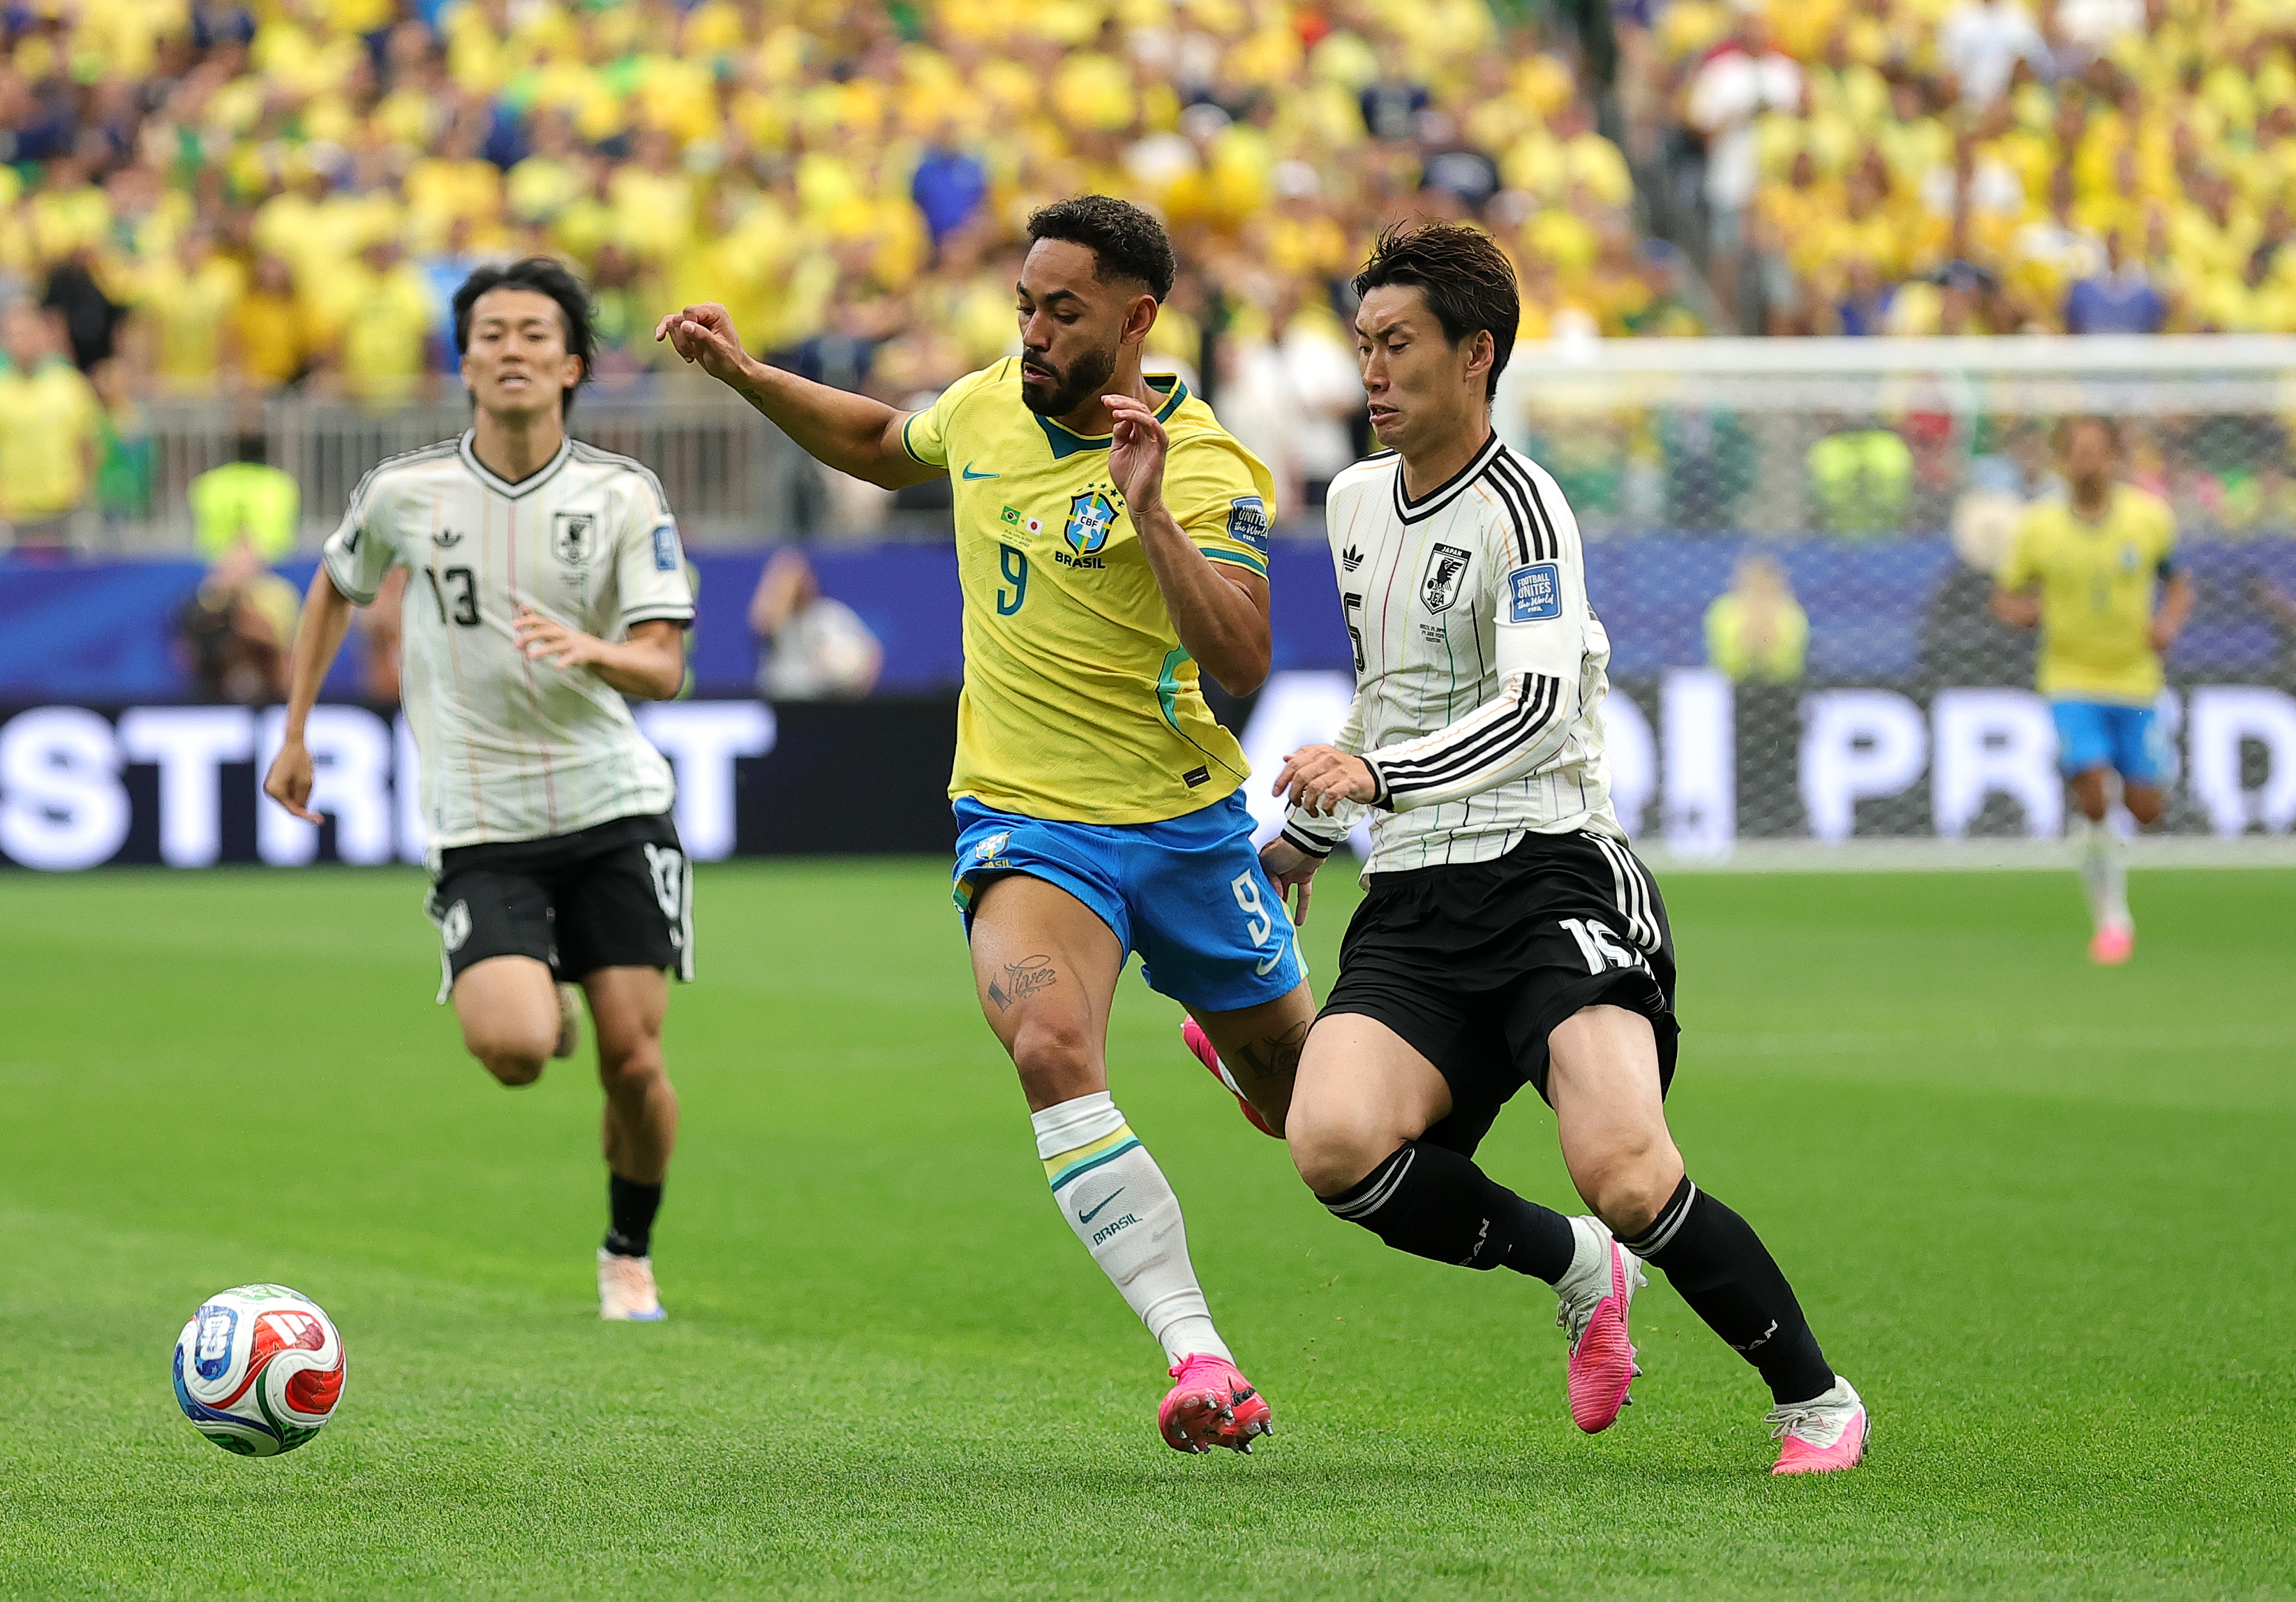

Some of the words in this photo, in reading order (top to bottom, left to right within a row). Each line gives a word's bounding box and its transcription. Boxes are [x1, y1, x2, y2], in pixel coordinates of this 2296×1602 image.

[1080, 517, 1098, 528] CBF
[1235, 521, 1246, 532] the
[1243, 534, 1255, 542] FIFA
[1054, 551, 1105, 569] BRASIL
[1441, 547, 1463, 556] JAPAN
[997, 542, 1028, 616] 9
[1517, 572, 1551, 588] FOOTBALL
[424, 567, 480, 625] 13
[1517, 581, 1551, 598] UNITES
[1516, 599, 1530, 609] the
[1530, 593, 1554, 606] World
[0, 704, 777, 871] STRT
[1230, 868, 1272, 948] 9
[1093, 1213, 1142, 1245] BRASIL
